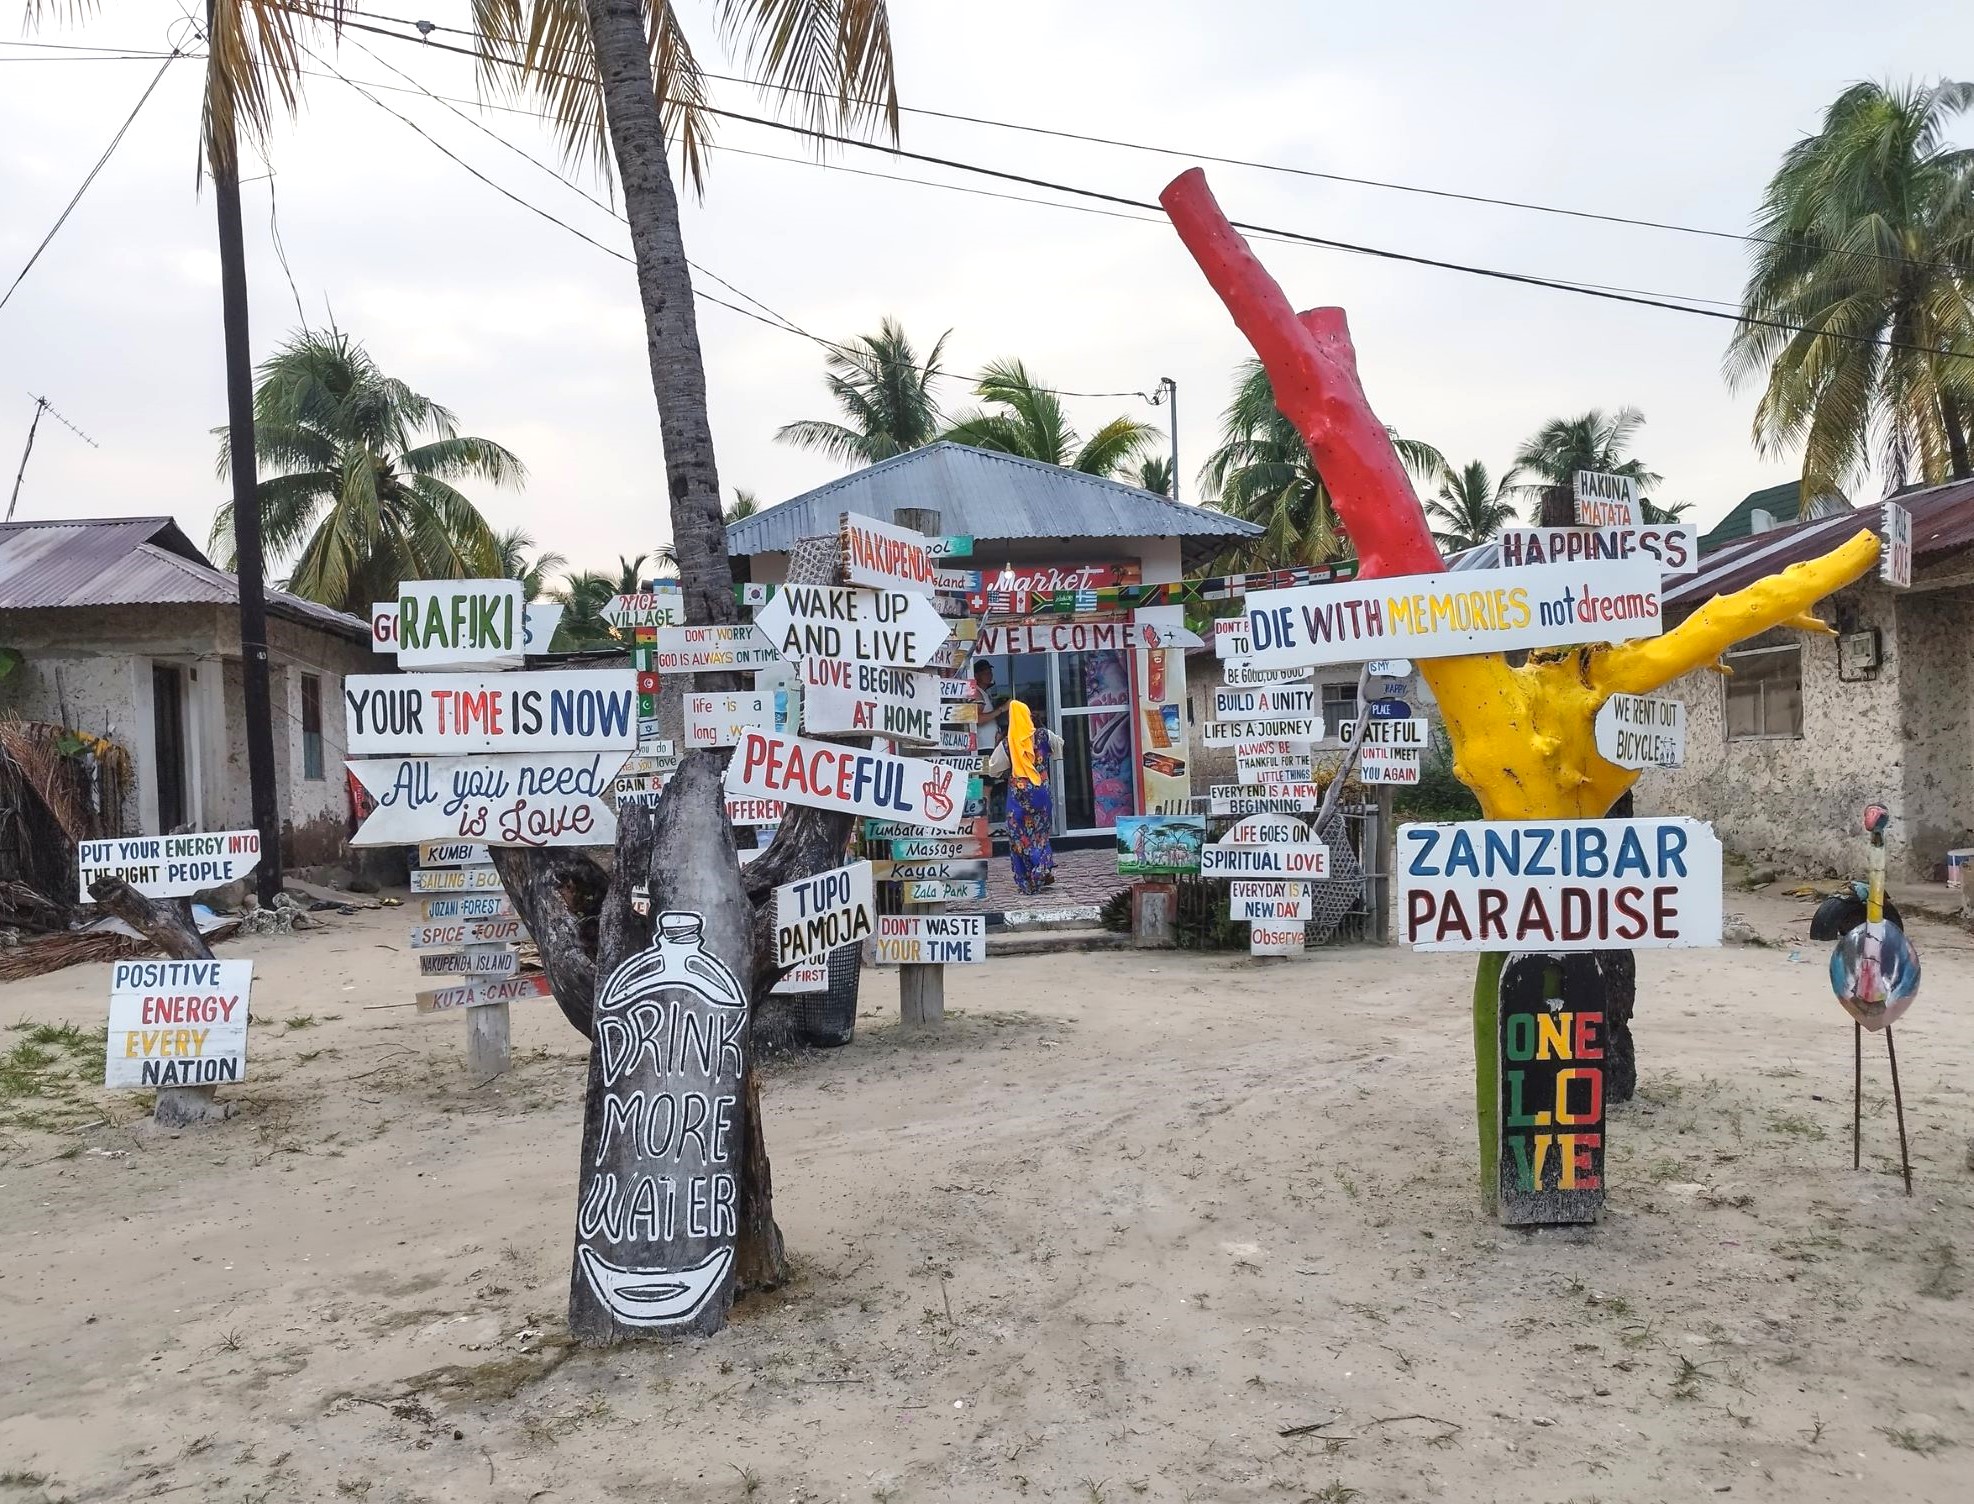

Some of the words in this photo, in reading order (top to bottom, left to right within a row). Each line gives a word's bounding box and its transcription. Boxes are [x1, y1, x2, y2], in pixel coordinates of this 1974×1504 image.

[1580, 471, 1631, 503] HAKUNA
[1581, 499, 1631, 526] MATATA
[850, 526, 935, 584] NAKUPENDA
[1503, 530, 1687, 568] HAPPINESS
[932, 573, 966, 588] sland
[987, 565, 1105, 592] Market
[619, 593, 659, 610] NICE
[783, 586, 858, 622] WAKE
[874, 592, 910, 624] UP
[400, 594, 514, 651] RAFIKI
[609, 608, 675, 627] VILLAGE
[1249, 606, 1297, 651] DIE
[1301, 599, 1384, 645] WITH
[1387, 587, 1532, 637] MEMORIES
[1540, 585, 1575, 627] not
[1577, 583, 1660, 623] dreams
[685, 628, 713, 642] DON'T
[716, 627, 754, 640] WORRY
[782, 623, 842, 658] AND
[855, 628, 917, 664] LIVE
[1231, 637, 1249, 654] TO
[658, 653, 678, 667] GOD
[680, 653, 690, 666] IS
[692, 651, 734, 666] ALWAYS
[736, 650, 750, 663] ON
[754, 649, 780, 663] TIME
[1378, 661, 1390, 672] MY
[808, 656, 852, 690] LOVE
[858, 664, 916, 699] BEGINS
[1228, 668, 1239, 684] BE
[692, 697, 713, 714] life
[727, 696, 737, 712] is
[753, 699, 762, 712] a
[1217, 693, 1254, 711] BUILD
[1259, 692, 1269, 711] A
[1272, 691, 1314, 711] UNITY
[1372, 704, 1391, 715] PLACE
[1613, 695, 1630, 722] WE
[1632, 697, 1656, 726] RENT
[1660, 701, 1677, 727] OUT
[346, 689, 423, 736] YOUR
[430, 690, 504, 736] TIME
[511, 690, 543, 735] IS
[550, 689, 632, 737] NOW
[852, 700, 878, 729] AT
[883, 704, 933, 740] HOME
[693, 723, 717, 745] long
[1204, 723, 1227, 739] LIFE
[1231, 723, 1242, 738] IS
[1245, 722, 1256, 737] A
[1257, 719, 1313, 737] JOURNEY
[656, 741, 667, 754] do
[940, 733, 969, 750] ISLAND
[1238, 741, 1275, 757] ALWAYS
[1278, 740, 1290, 754] BE
[1616, 729, 1661, 762] BICYCLE
[638, 760, 652, 771] you
[656, 757, 677, 768] love
[1238, 758, 1279, 769] THANKFUL
[1281, 756, 1293, 767] FOR
[1294, 755, 1310, 766] THE
[1362, 747, 1388, 759] UNTIL
[1394, 747, 1417, 760] MEET
[742, 733, 914, 812] PEACEFUL
[1256, 770, 1284, 783] LITTLE
[1284, 769, 1311, 780] THINGS
[1362, 766, 1380, 780] YOU
[1383, 767, 1417, 781] AGAIN
[380, 761, 438, 810] All
[443, 765, 509, 816] you
[516, 753, 605, 798] need
[616, 777, 646, 792] GAIN
[652, 776, 662, 790] &
[1211, 786, 1245, 798] EVERY
[1246, 784, 1266, 797] END
[1269, 785, 1279, 797] IS
[1282, 785, 1290, 797] A
[1293, 784, 1318, 798] NEW
[617, 793, 662, 809] MAINTA
[725, 799, 784, 820] IFFEREN
[1229, 798, 1302, 813] BEGINNING
[459, 803, 489, 837] is
[498, 798, 595, 847] Love
[1233, 825, 1257, 842] LIFE
[1259, 825, 1289, 842] GOES
[1292, 825, 1310, 842] ON
[80, 843, 113, 863] PUT
[118, 841, 160, 860] YOUR
[165, 836, 226, 858] ENERGY
[229, 835, 259, 853] INTO
[427, 845, 474, 862] KUMBI
[905, 842, 963, 858] Massage
[1406, 825, 1688, 879] ZANZIBAR
[115, 865, 160, 884] RIGHT
[168, 860, 233, 883] PEOPLE
[1202, 850, 1282, 872] SPIRITUAL
[1286, 853, 1325, 873] LOVE
[419, 872, 466, 889] SAILING
[475, 872, 502, 887] BO
[1233, 882, 1286, 898] EVERYDAY
[1288, 883, 1300, 897] IS
[1301, 883, 1311, 898] A
[793, 871, 850, 918] TUPO
[428, 900, 459, 917] JOZANI
[463, 898, 502, 915] FOREST
[1245, 901, 1275, 918] NEW
[1276, 902, 1300, 918] DAY
[1407, 885, 1680, 943] PARADISE
[422, 926, 466, 944] SPICE
[475, 922, 520, 938] TOUR
[779, 904, 871, 964] PAMOJA
[881, 917, 921, 936] DON'T
[926, 917, 979, 936] WASTE
[1252, 928, 1306, 945] Observe
[878, 939, 921, 961] YOUR
[926, 940, 973, 962] TIME
[421, 955, 472, 972] NAKUPENDA
[476, 954, 513, 971] ISLAND
[115, 963, 221, 988] POSITIVE
[795, 969, 827, 982] FIRST
[432, 989, 475, 1009] KUZA
[486, 980, 530, 999] CAVE
[141, 995, 239, 1025] ENERGY
[125, 1028, 210, 1058] EVERY
[596, 1000, 747, 1088] DRINK
[1506, 1011, 1604, 1061] ONE
[141, 1057, 237, 1087] NATION
[596, 1090, 737, 1167] MORE
[1506, 1133, 1601, 1192] VE
[578, 1172, 737, 1245] WATER
